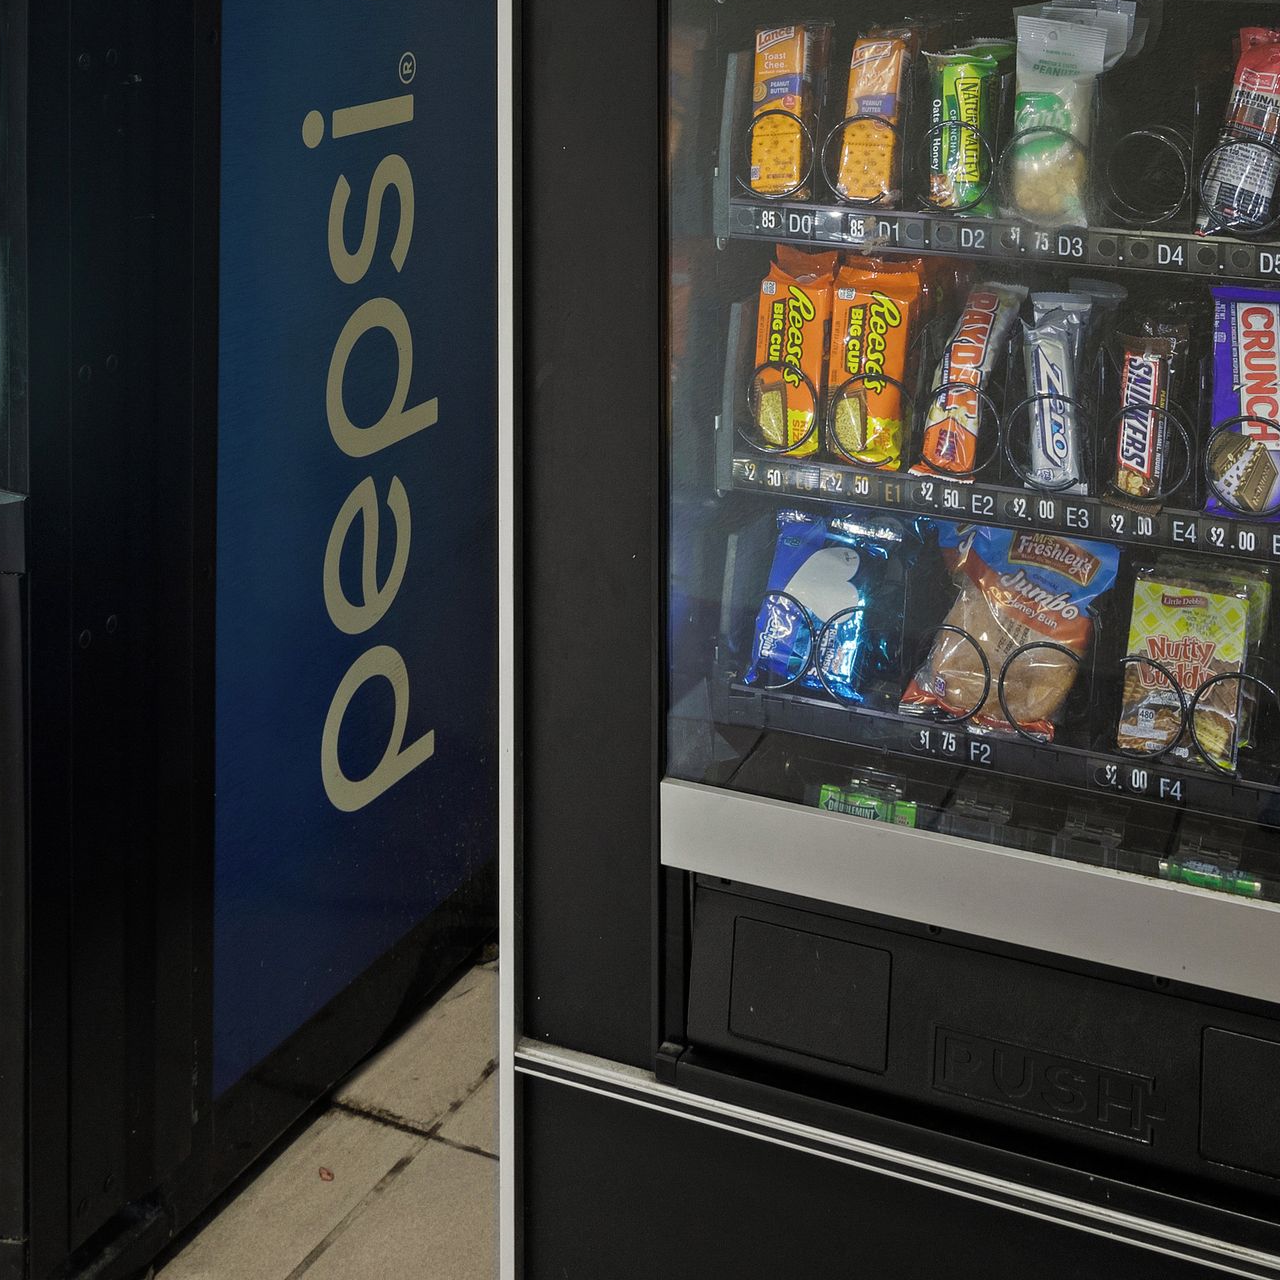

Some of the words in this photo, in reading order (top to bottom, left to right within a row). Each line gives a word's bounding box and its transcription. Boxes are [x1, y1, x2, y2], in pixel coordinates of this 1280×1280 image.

[757, 27, 794, 49] Lance
[961, 229, 985, 248] D2
[1058, 234, 1083, 256] D3
[1158, 245, 1183, 266] D4
[850, 308, 863, 339] BIG
[846, 339, 860, 374] CUP
[1240, 305, 1280, 447] CRUNCH
[302, 94, 439, 812] pepsi
[972, 495, 994, 515] E2
[1066, 508, 1089, 528] E3
[1173, 521, 1197, 543] E4
[1001, 571, 1079, 620] Jumbo
[1146, 636, 1215, 663] Nutty
[971, 743, 992, 764] F2
[1160, 779, 1182, 800] F4
[944, 1037, 1142, 1130] PUSH
